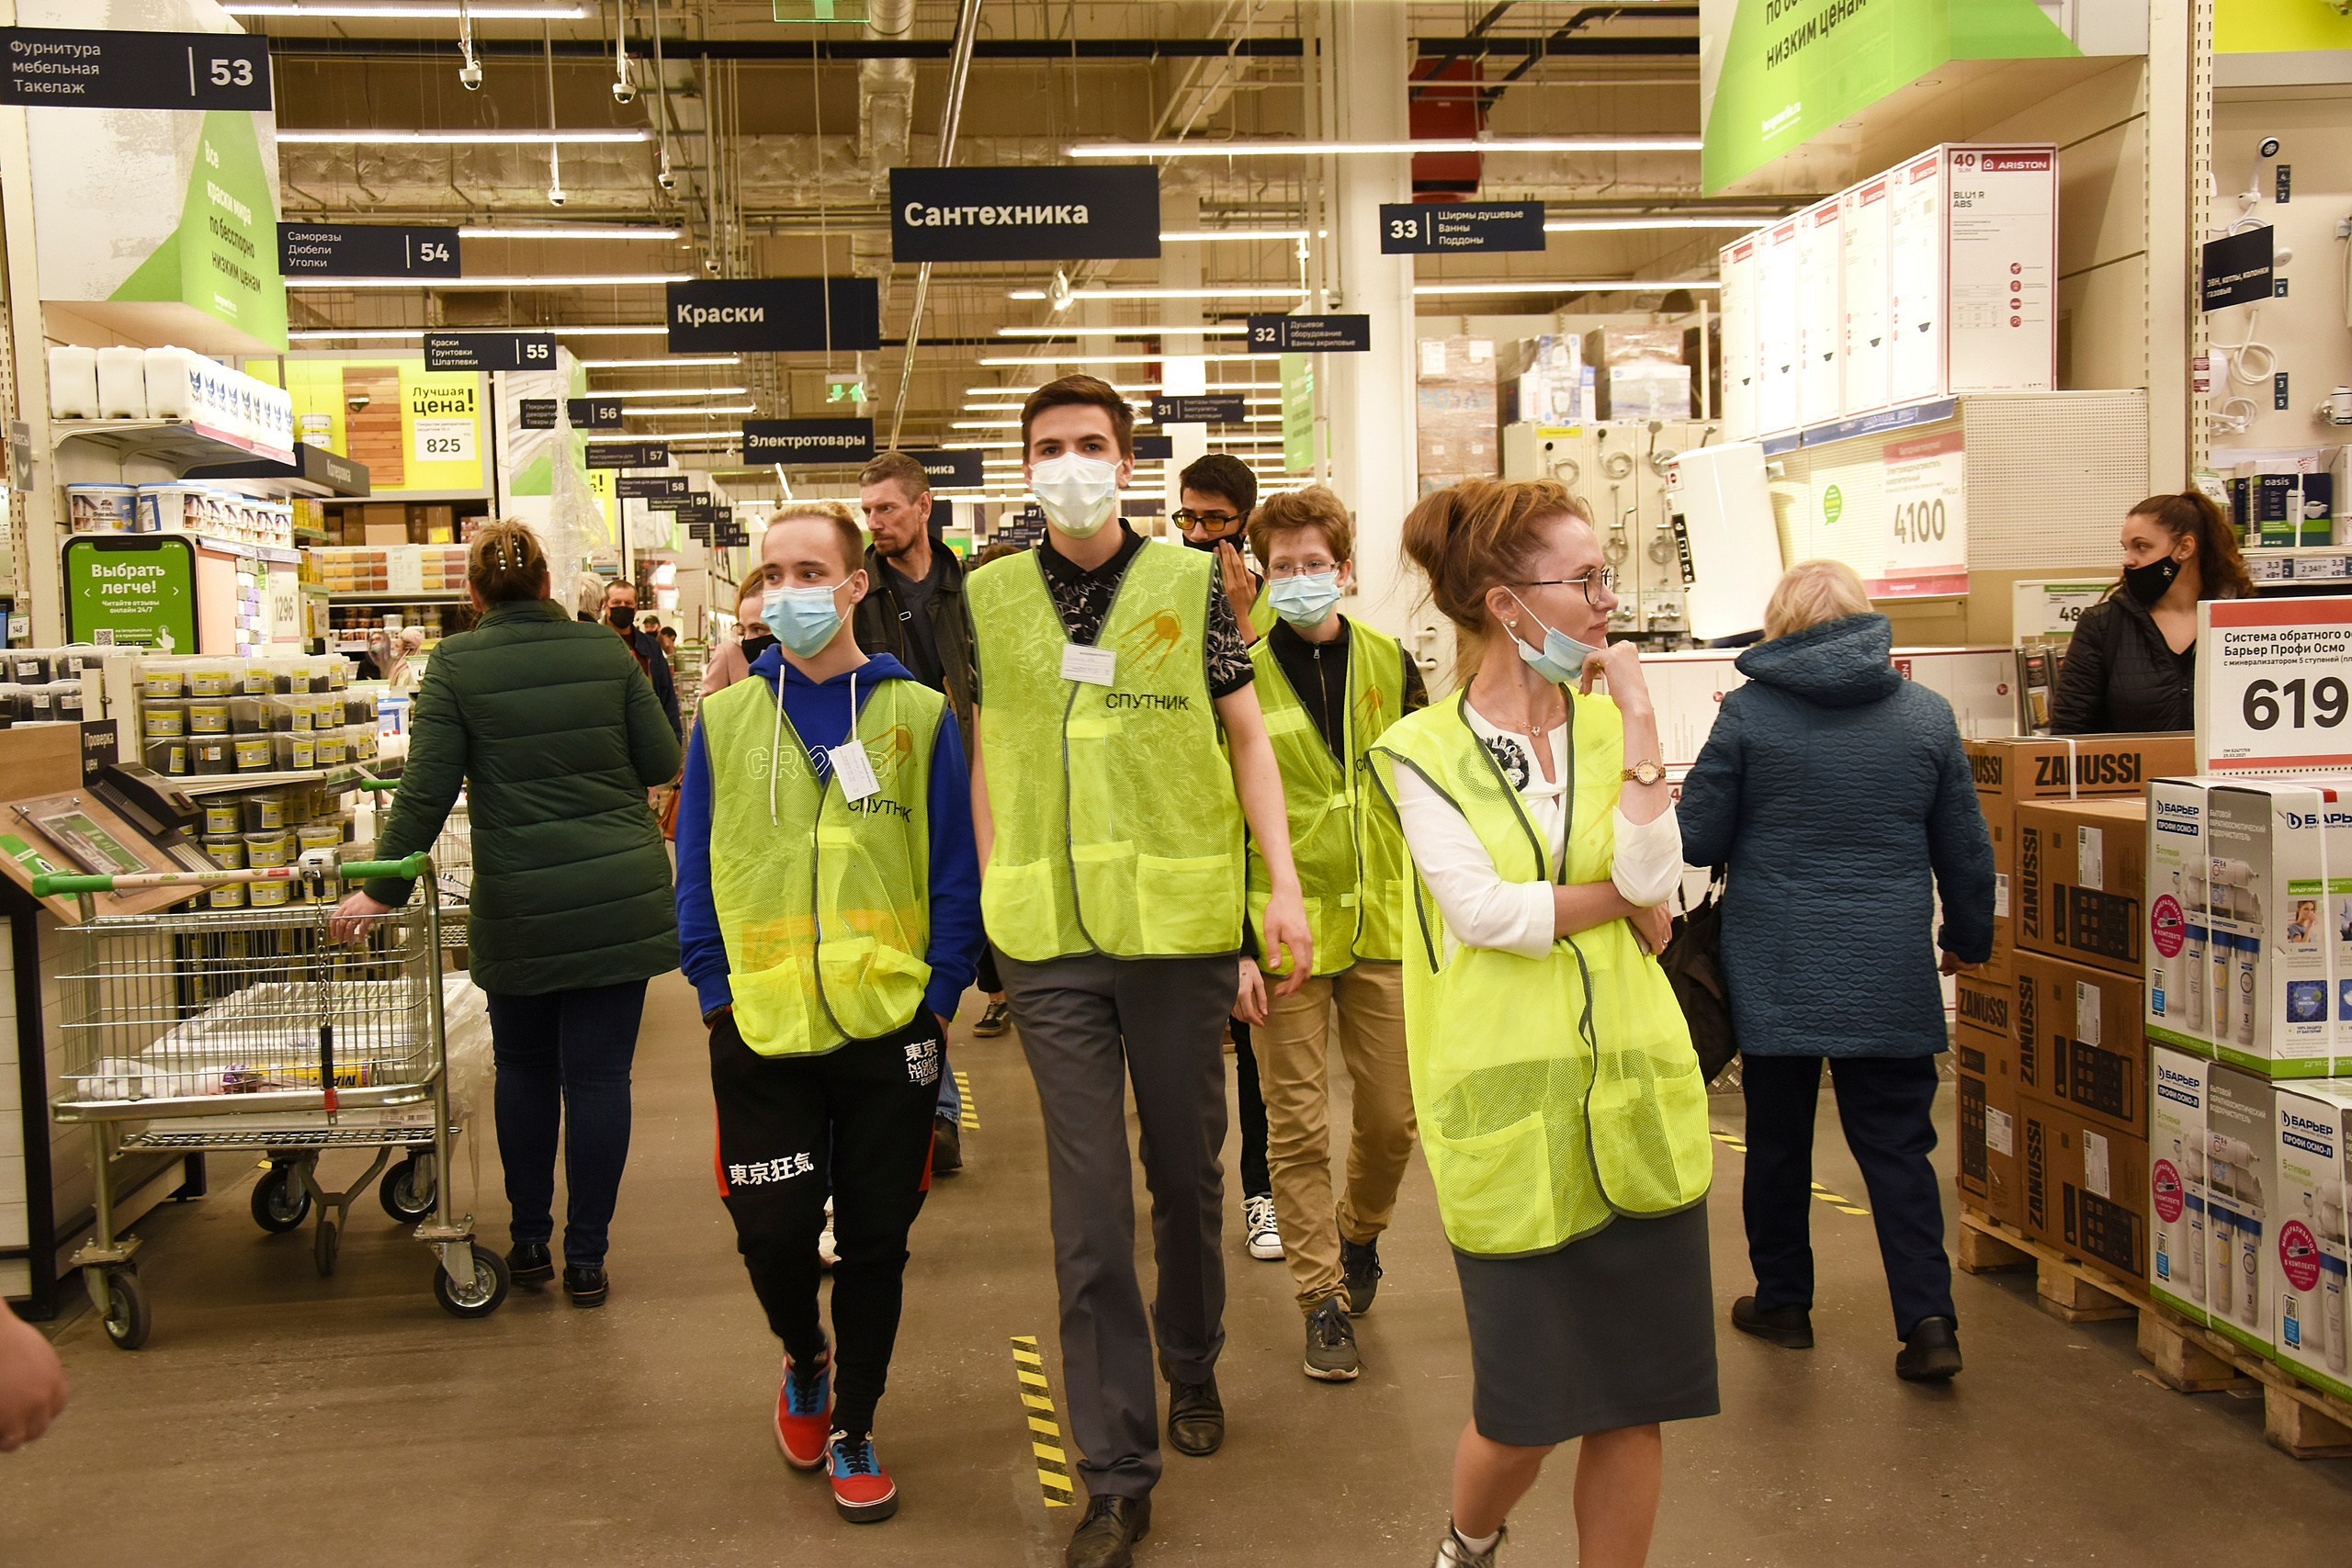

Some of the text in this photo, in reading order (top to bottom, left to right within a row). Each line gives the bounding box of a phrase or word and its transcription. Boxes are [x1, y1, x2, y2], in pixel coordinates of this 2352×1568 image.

[10, 39, 101, 59] Фурнитура
[1767, 17, 1815, 71] низким
[12, 61, 99, 75] мебельная
[210, 59, 254, 86] 53
[14, 79, 85, 94] Такелаж
[204, 140, 220, 169] Все
[1954, 153, 1975, 166] 40
[207, 179, 252, 227] краски мира
[904, 201, 1089, 228] Сантехника
[1438, 210, 1523, 221] Ширмы душевые
[1390, 220, 1418, 239] 33
[1438, 223, 1470, 232] Ванны
[209, 216, 255, 259] по бесспорно
[288, 231, 342, 243] Саморезы
[1439, 236, 1484, 246] Поддоны
[288, 244, 332, 255] Дюбели
[420, 243, 449, 262] 54
[288, 258, 327, 267] Уголки
[212, 250, 261, 294] низким ценам
[2243, 266, 2269, 278] колонки
[2207, 287, 2232, 298] газовые
[676, 303, 764, 327] Краски
[1255, 327, 1275, 342] 32
[432, 349, 472, 357] Грунтовки
[526, 344, 548, 359] 55
[413, 388, 464, 399] Лучшая
[413, 389, 474, 416] цена!
[1159, 404, 1171, 415] 31
[600, 408, 616, 419] 56
[13, 433, 28, 446] ВЕСЫ
[426, 439, 461, 453] 825
[748, 432, 866, 451] Электротовары
[650, 451, 662, 459] 57
[672, 482, 684, 491] 58
[2265, 478, 2290, 486] oasis
[696, 497, 707, 505] 59
[1894, 498, 1945, 544] 4100
[92, 563, 165, 580] Выбрать
[2267, 561, 2279, 570] 3,3
[100, 581, 156, 595] легче!
[275, 596, 294, 622] 1296
[2224, 630, 2341, 643] Система обратного
[2224, 643, 2345, 657] Барьер Профи Осмо
[2229, 659, 2297, 667] минерализатором
[2304, 656, 2339, 664] ступеней
[1105, 693, 1189, 710] СПУТНИК
[2243, 677, 2348, 730] 619
[85, 733, 114, 750] Проверка
[85, 759, 97, 774] цен
[2165, 803, 2199, 816] БАРЬЕР
[2210, 809, 2231, 818] БЫТОВОЙ
[2158, 821, 2198, 834] ПРОФИ ОСМО-Л
[2210, 819, 2266, 833] ОБРАТНООСМОТИЧЕСКИЙ
[2210, 829, 2251, 841] ВОДООЧИСТИТЕЛЬ
[2023, 828, 2038, 939] ZANUSSI
[2154, 899, 2183, 926] МИНЕРАЛИЗАТОР
[2158, 929, 2181, 942] КОМПЛЕКТЕ
[1959, 987, 2007, 1029] ZANUSSI
[2018, 975, 2035, 1087] ZANUSSI
[904, 1039, 938, 1062] 東京
[2165, 1070, 2199, 1088] БАРЬЕР
[2159, 1087, 2198, 1107] ПРОФИ ОСМО-Л
[2210, 1085, 2232, 1098] БЫТОВОЙ
[2210, 1094, 2266, 1119] ОБРАТНООСМОТИЧЕСКИЙ
[2210, 1103, 2251, 1123] ВОДООЧИСТИТЕЛЬ
[2291, 1116, 2333, 1135] БАРЬЕР
[2284, 1134, 2305, 1148] ПРОФИ
[2306, 1141, 2331, 1156] ОСМО-Л
[729, 1152, 814, 1186] 東京狂気
[2283, 1158, 2288, 1168] 5
[2027, 1118, 2043, 1232] ZANUSSI
[2154, 1162, 2180, 1191] МИНЕРАЛИЗАТОР
[2157, 1194, 2180, 1206] КОМПЛЕКТЕ
[2282, 1225, 2315, 1255] МИНЕРАЛИЗАТОР
[2288, 1259, 2316, 1271] КОМПЛЕКТЕ
